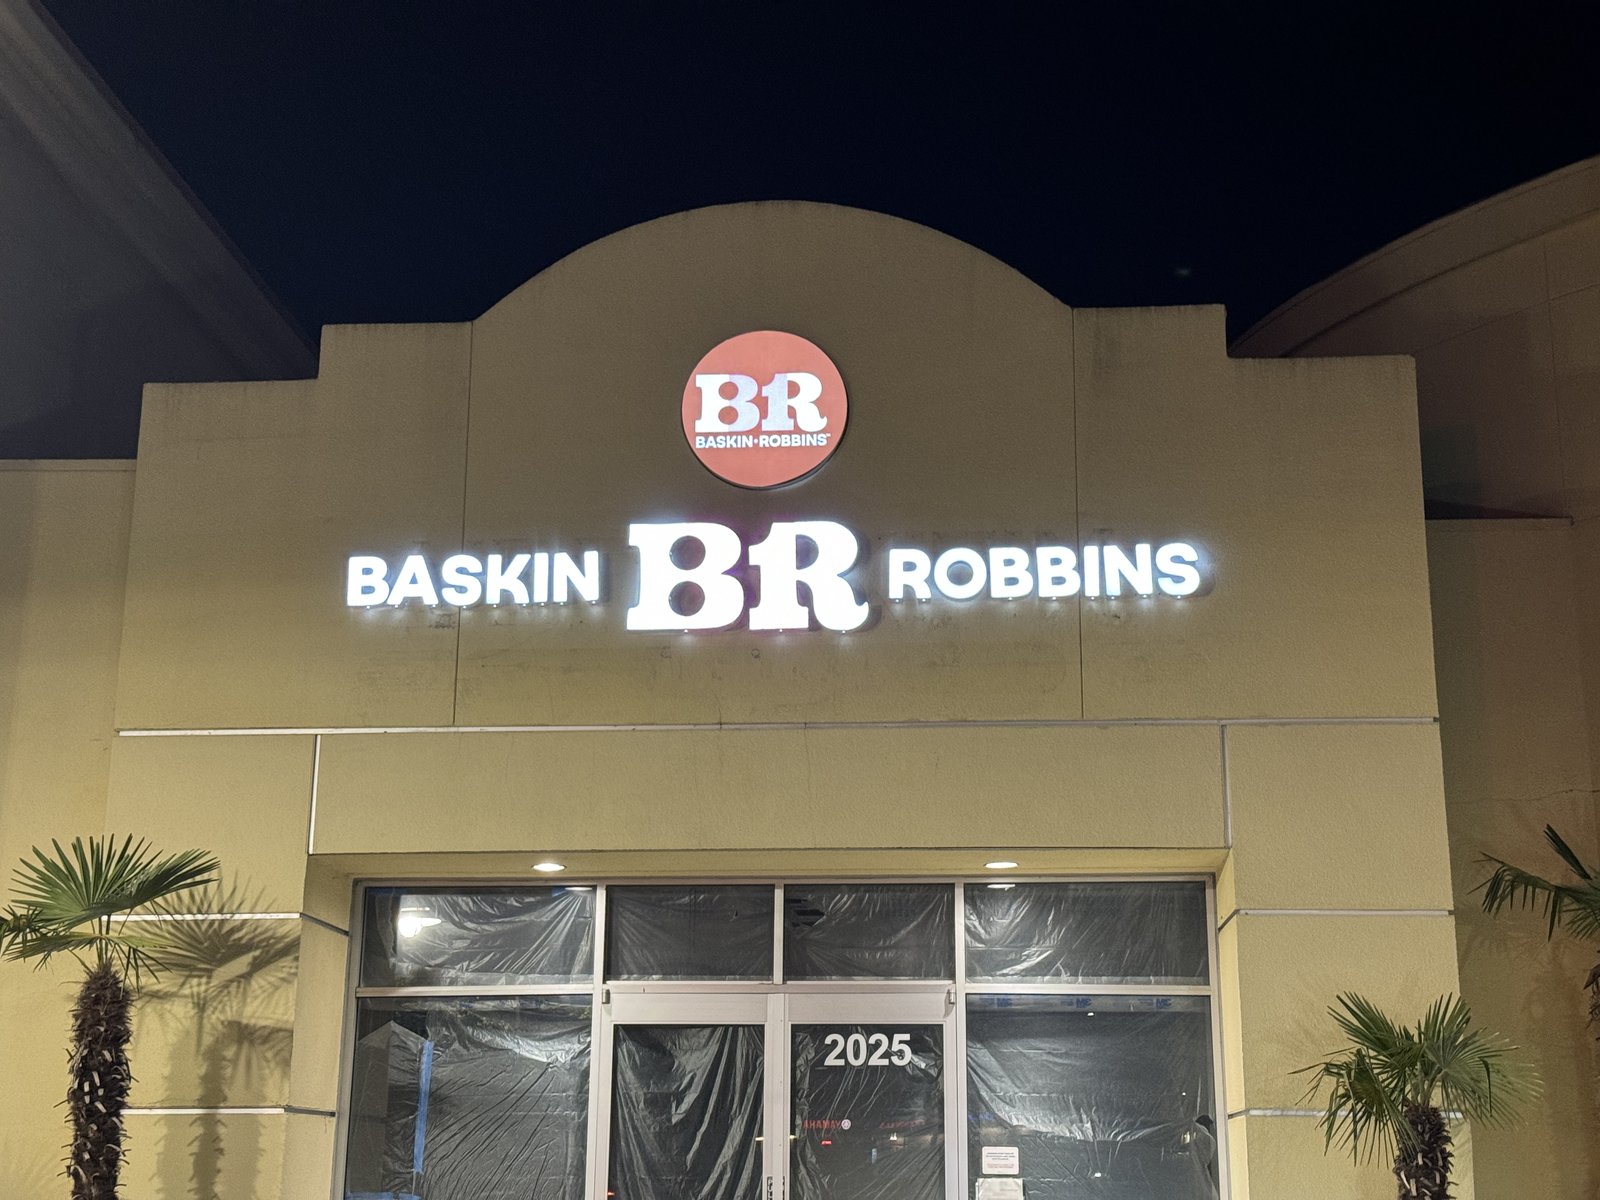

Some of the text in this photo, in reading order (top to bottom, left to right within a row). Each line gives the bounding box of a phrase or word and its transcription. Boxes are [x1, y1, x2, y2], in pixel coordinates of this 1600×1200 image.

[695, 372, 828, 432] BR
[347, 520, 1200, 631] BASKIN BR ROBBINS
[824, 1033, 912, 1066] 2025
